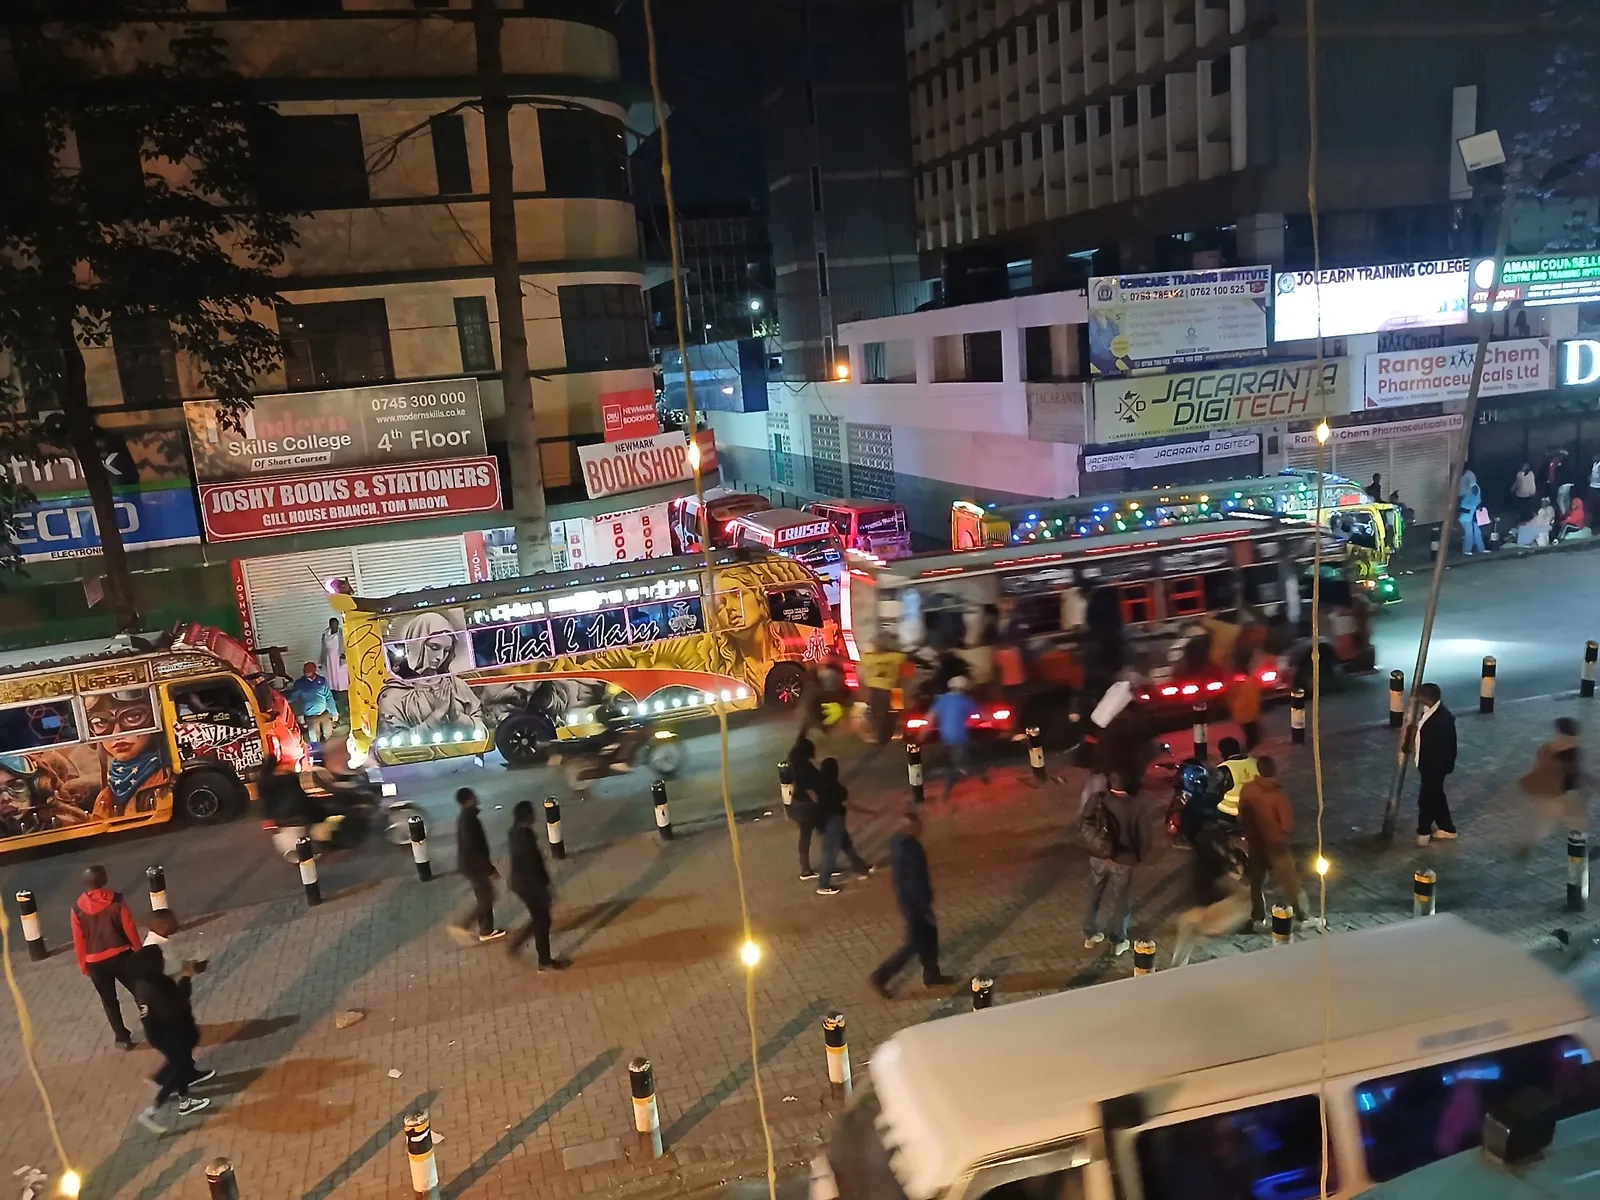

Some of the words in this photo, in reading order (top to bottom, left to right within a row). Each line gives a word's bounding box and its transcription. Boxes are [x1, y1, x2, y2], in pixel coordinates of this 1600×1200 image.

[1357, 262, 1415, 281] TRAINING
[1417, 259, 1470, 277] COLLEGE
[1503, 259, 1540, 274] AMANI
[1172, 272, 1218, 286] TRAINING
[1190, 287, 1211, 297] 0762
[1213, 286, 1228, 295] 100
[1230, 284, 1245, 294] 525
[1378, 355, 1448, 376] Range
[1483, 346, 1540, 365] Chem
[1152, 363, 1338, 404] JACARANTA
[1378, 367, 1513, 395] Pharmaceucals
[1517, 363, 1539, 380] Ltd
[371, 396, 407, 411] 0745
[410, 393, 437, 408] 300
[440, 391, 466, 405] 000
[622, 404, 654, 415] NEWMARK
[1173, 389, 1310, 426] DIGITECH
[376, 407, 466, 424] www.modernskills.co.ke
[623, 413, 656, 425] BOOKSHOP
[377, 428, 403, 452] 4th
[410, 428, 471, 450] Floor
[1295, 433, 1322, 444] Ran
[1340, 430, 1369, 440] Chem
[1372, 420, 1448, 436] Pharmaceuticals
[1449, 417, 1462, 426] Ltd
[228, 439, 278, 456] Skills
[282, 434, 352, 451] College
[615, 438, 655, 453] NEWMARK
[1154, 444, 1210, 459] JACARANTA
[1215, 439, 1256, 451] DIGITECH
[254, 458, 266, 469] Of
[268, 457, 292, 467] Short
[294, 454, 327, 464] Courses
[585, 445, 687, 495] BOOKSHOP
[212, 486, 275, 514] JOSHY
[279, 479, 350, 506] BOOKS
[354, 480, 370, 498] &
[372, 465, 491, 496] STATIONERS
[262, 513, 288, 527] GILL
[289, 508, 328, 524] HOUSE
[382, 500, 406, 513] TOM
[407, 495, 449, 511] MBOYA
[4, 502, 140, 545] ECNO
[777, 521, 831, 543] CRUISER
[51, 547, 104, 559] ELECTRONI
[472, 549, 482, 582] JOSH
[236, 576, 246, 617] JOSHY
